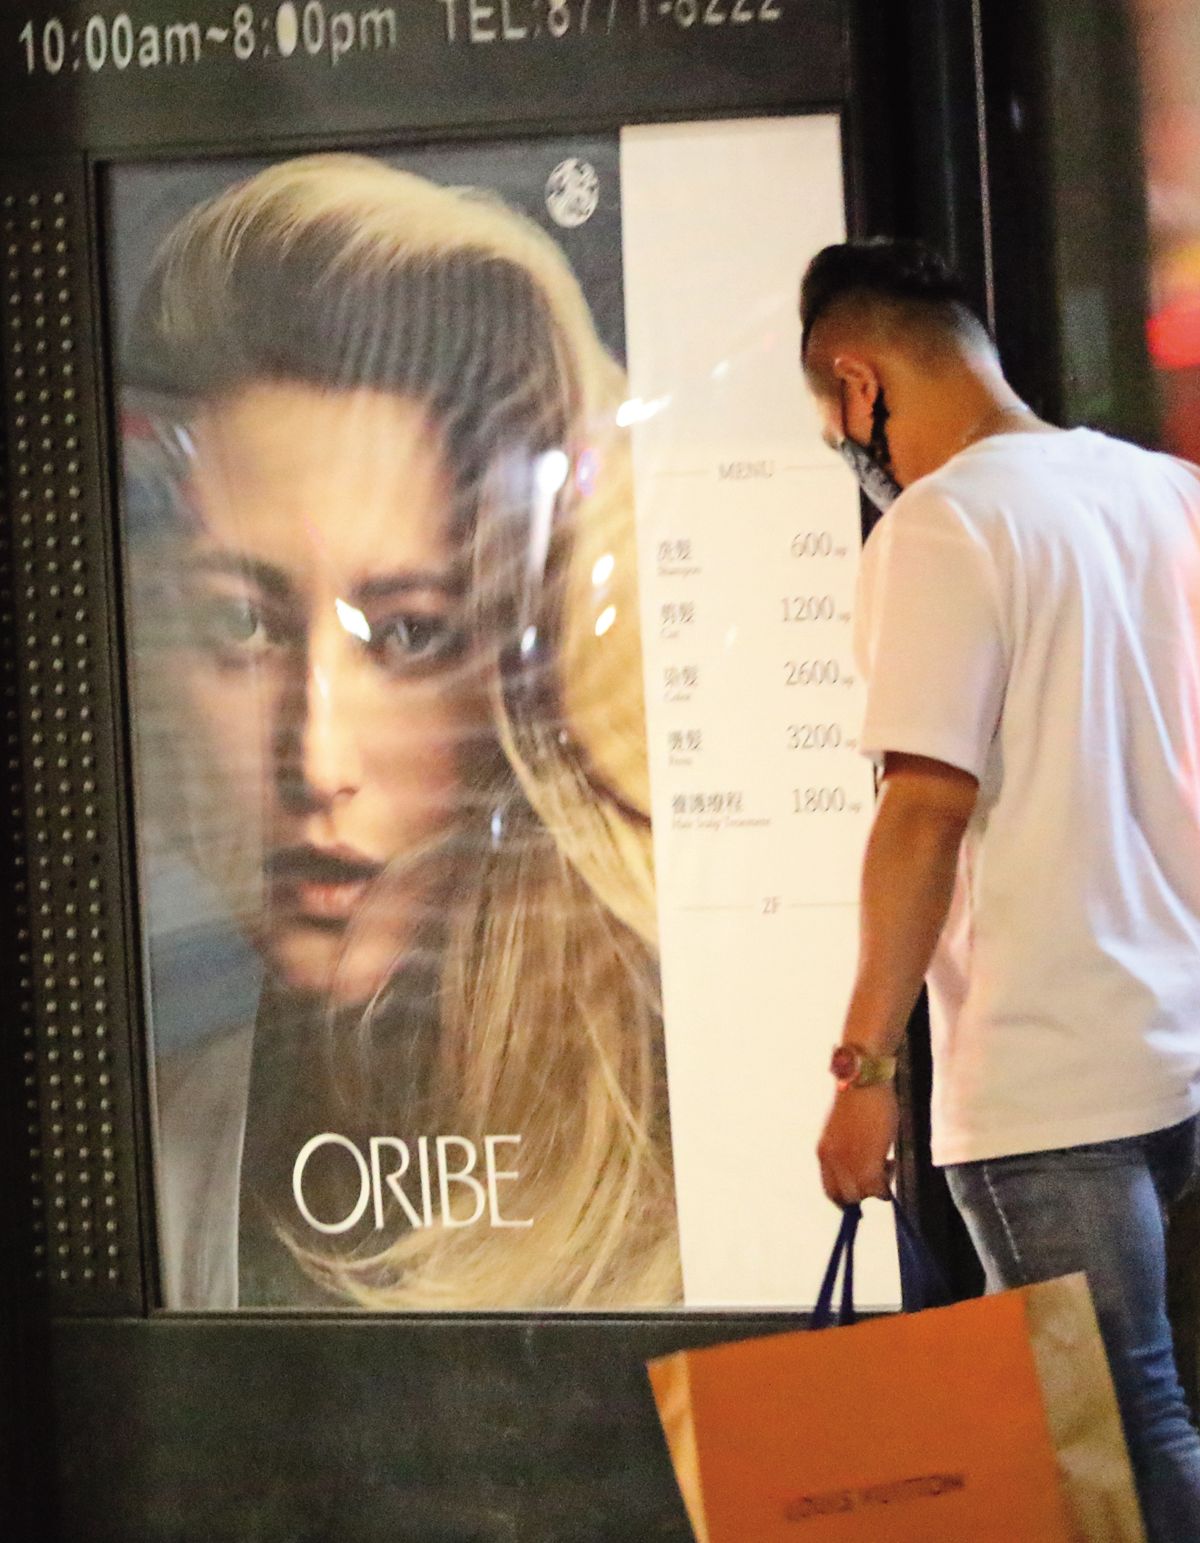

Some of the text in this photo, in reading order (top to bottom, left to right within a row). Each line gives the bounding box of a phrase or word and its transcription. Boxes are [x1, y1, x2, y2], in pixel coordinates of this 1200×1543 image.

[717, 459, 776, 482] MENU
[790, 530, 833, 558] 600
[781, 595, 836, 623] 1200
[783, 658, 840, 687] 2600
[786, 723, 842, 750] 3200
[792, 786, 848, 814] 1800
[292, 1132, 534, 1235] ORIBE
